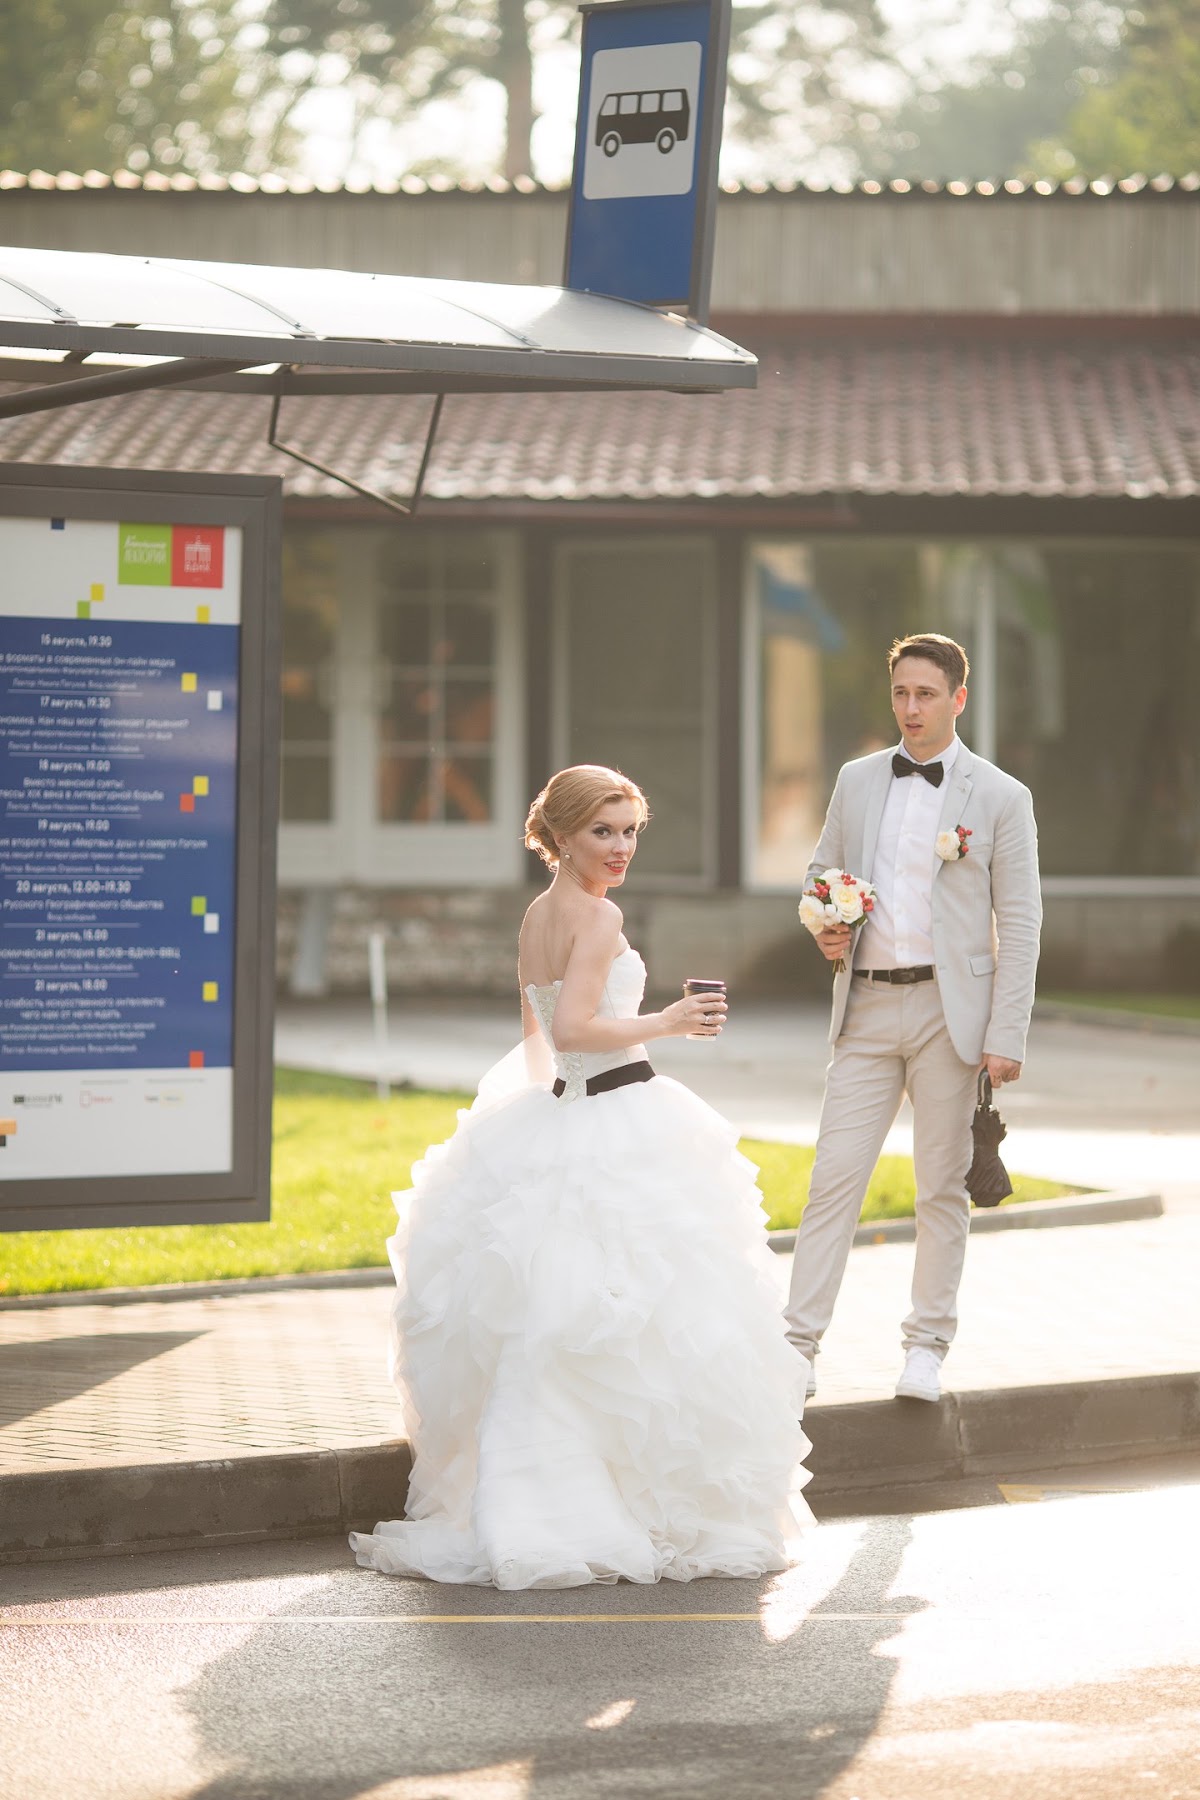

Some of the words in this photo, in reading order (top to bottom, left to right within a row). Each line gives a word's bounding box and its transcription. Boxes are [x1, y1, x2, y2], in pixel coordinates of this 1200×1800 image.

[52, 637, 87, 648] августа,
[88, 635, 112, 648] 19.30
[40, 696, 50, 708] 17
[51, 699, 86, 710] августа,
[87, 697, 111, 709] 19.30
[50, 761, 85, 773] августа,
[49, 822, 84, 833] августа,
[16, 880, 30, 893] 20
[31, 884, 71, 896] августа,
[35, 929, 45, 941] 21
[47, 932, 82, 943] августа,
[34, 979, 45, 991] 21
[46, 982, 81, 993] августа,
